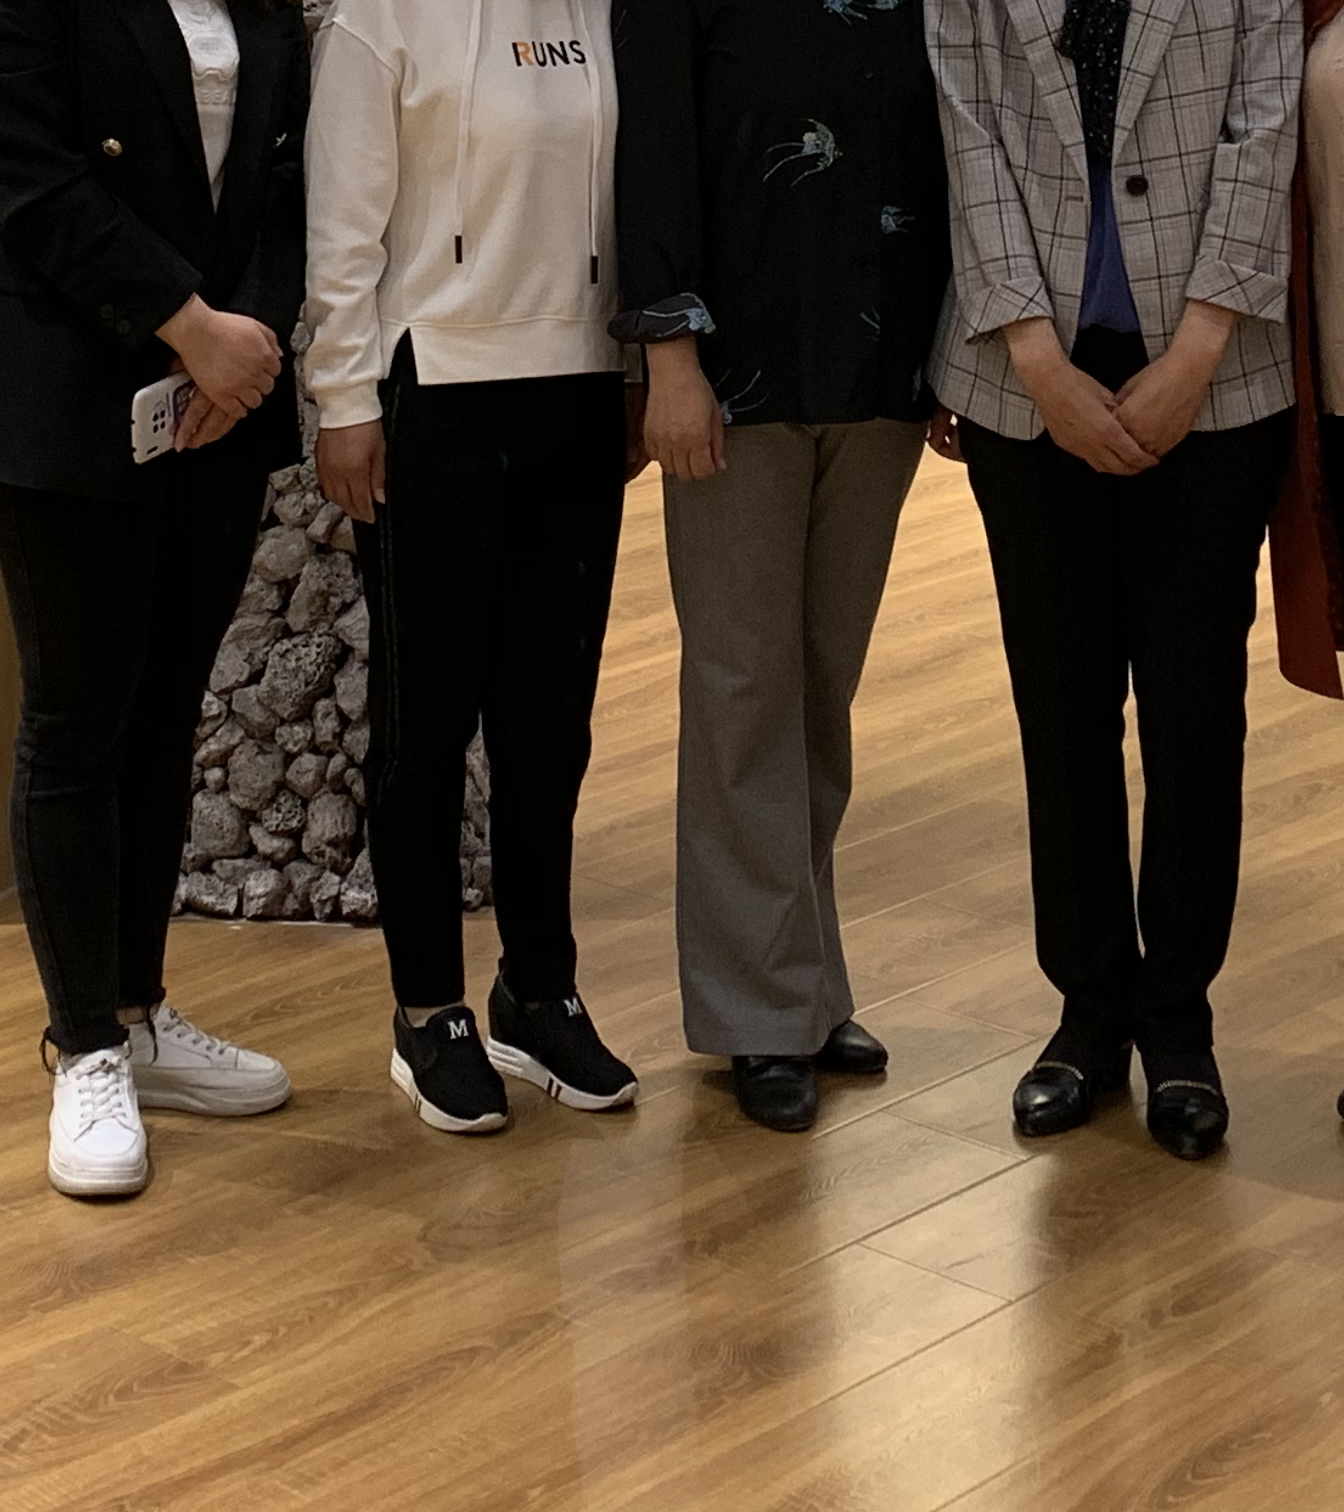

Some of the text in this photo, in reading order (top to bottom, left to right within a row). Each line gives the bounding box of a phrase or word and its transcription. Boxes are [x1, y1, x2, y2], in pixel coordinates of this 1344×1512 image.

[511, 40, 587, 67] RUNS
[562, 997, 583, 1017] M
[447, 1018, 469, 1040] M
